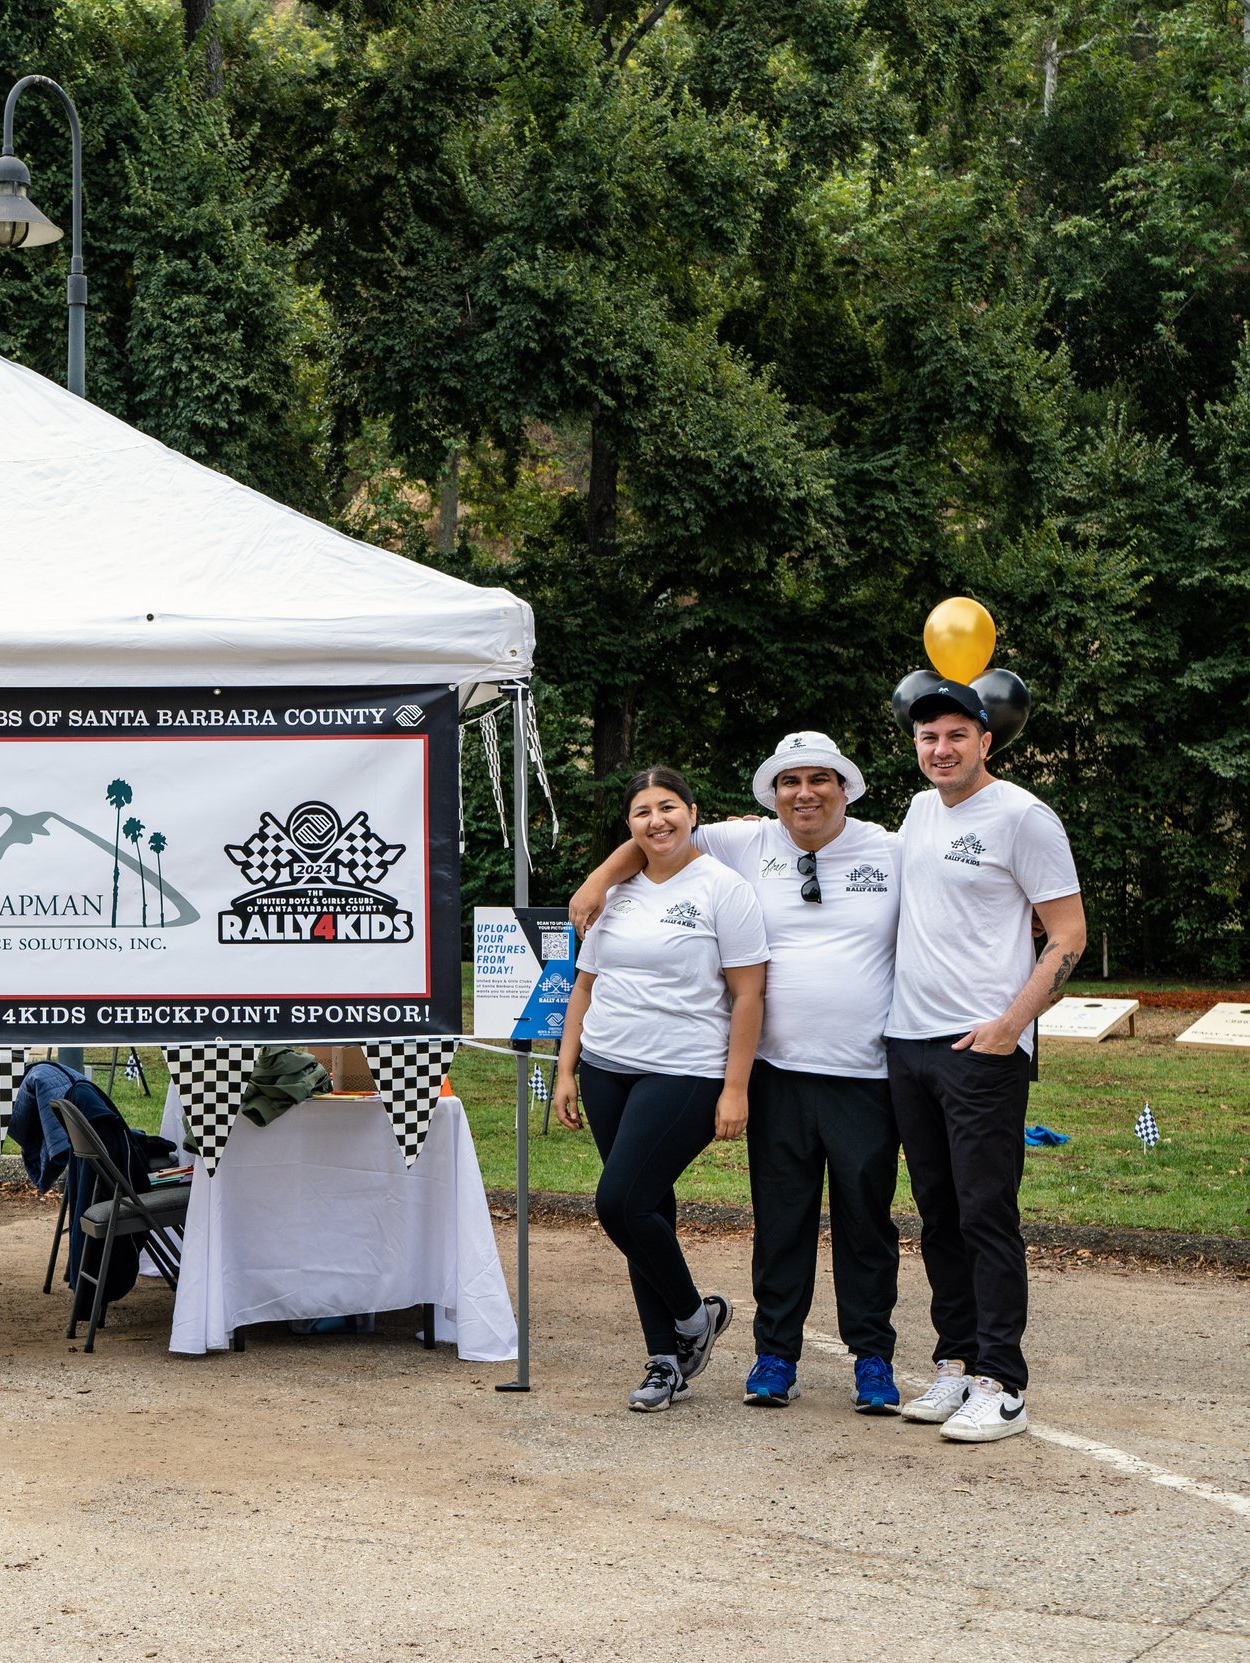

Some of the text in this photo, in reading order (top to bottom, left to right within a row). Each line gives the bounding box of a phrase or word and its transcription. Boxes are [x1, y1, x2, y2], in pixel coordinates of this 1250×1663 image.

[29, 709, 62, 727] OF
[68, 709, 150, 727] SANTA
[157, 709, 278, 727] BARBARA
[284, 708, 386, 726] COUNTY
[944, 854, 960, 862] RALLY
[296, 865, 332, 875] 2024
[477, 924, 517, 933] UPLOAD
[681, 920, 696, 928] KIDS
[477, 934, 504, 943] YOUR
[17, 937, 123, 953] SOLUTIONS,
[130, 937, 167, 950] INC.
[477, 945, 526, 954] PICTURES
[477, 956, 505, 964] FROM
[477, 965, 514, 975] TODAY!
[96, 1005, 280, 1025] CHECKPOINT
[291, 1005, 432, 1025] SPONSOR!
